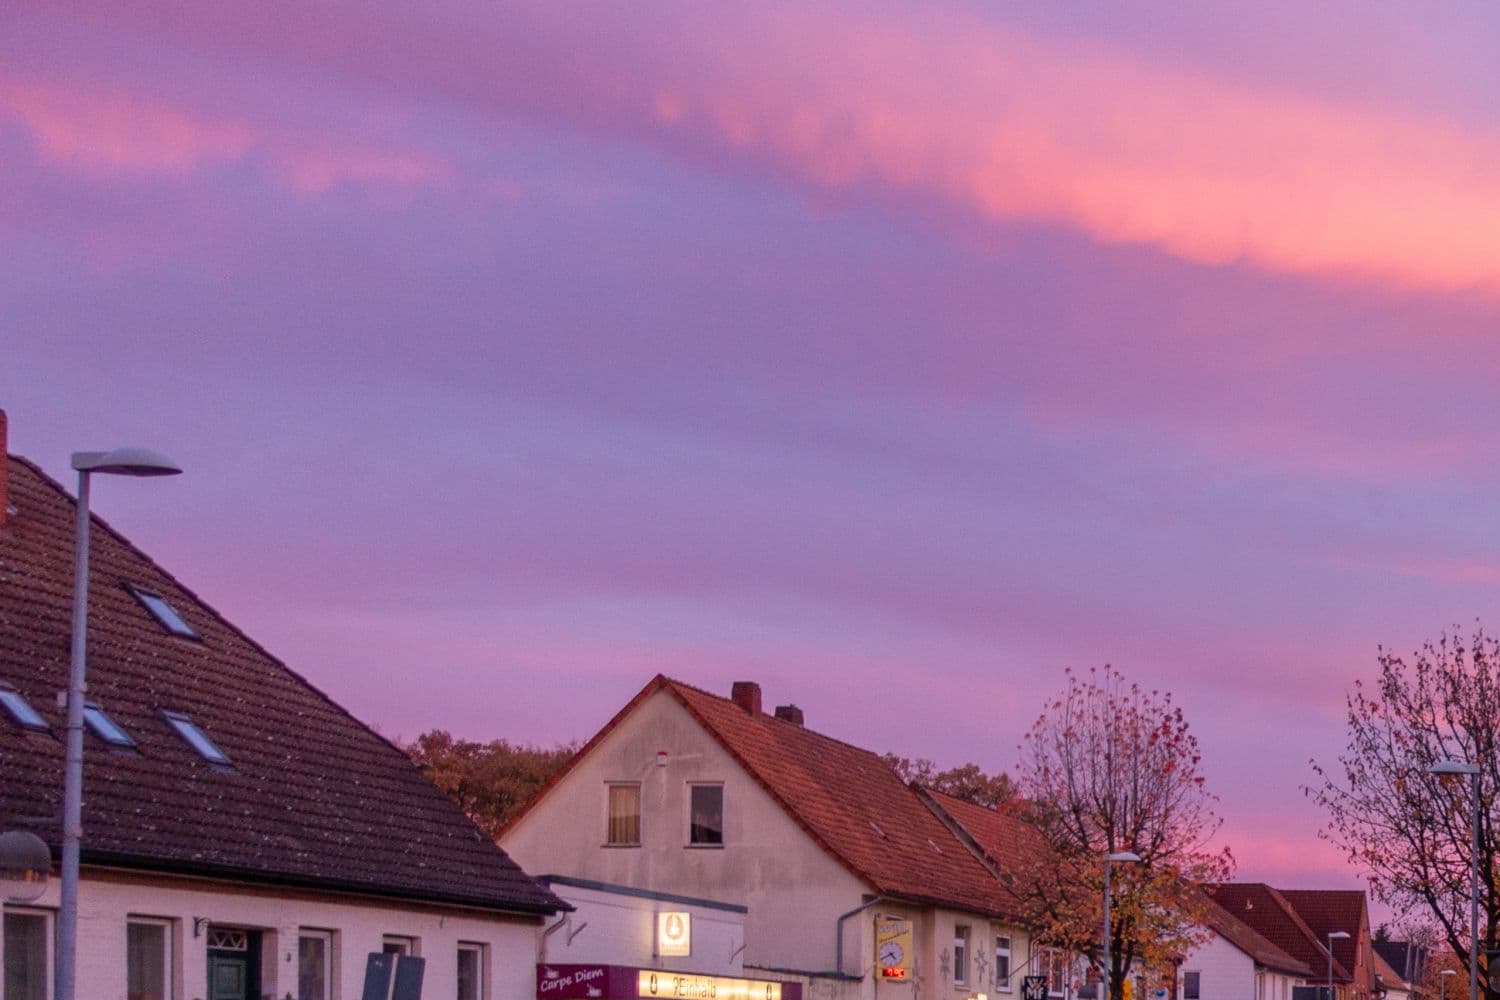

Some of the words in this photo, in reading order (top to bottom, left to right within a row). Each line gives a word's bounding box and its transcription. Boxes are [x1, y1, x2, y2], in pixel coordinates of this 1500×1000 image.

[540, 975, 573, 993] Carpe
[575, 967, 604, 985] Diem
[673, 976, 717, 998] 9Einhalb
